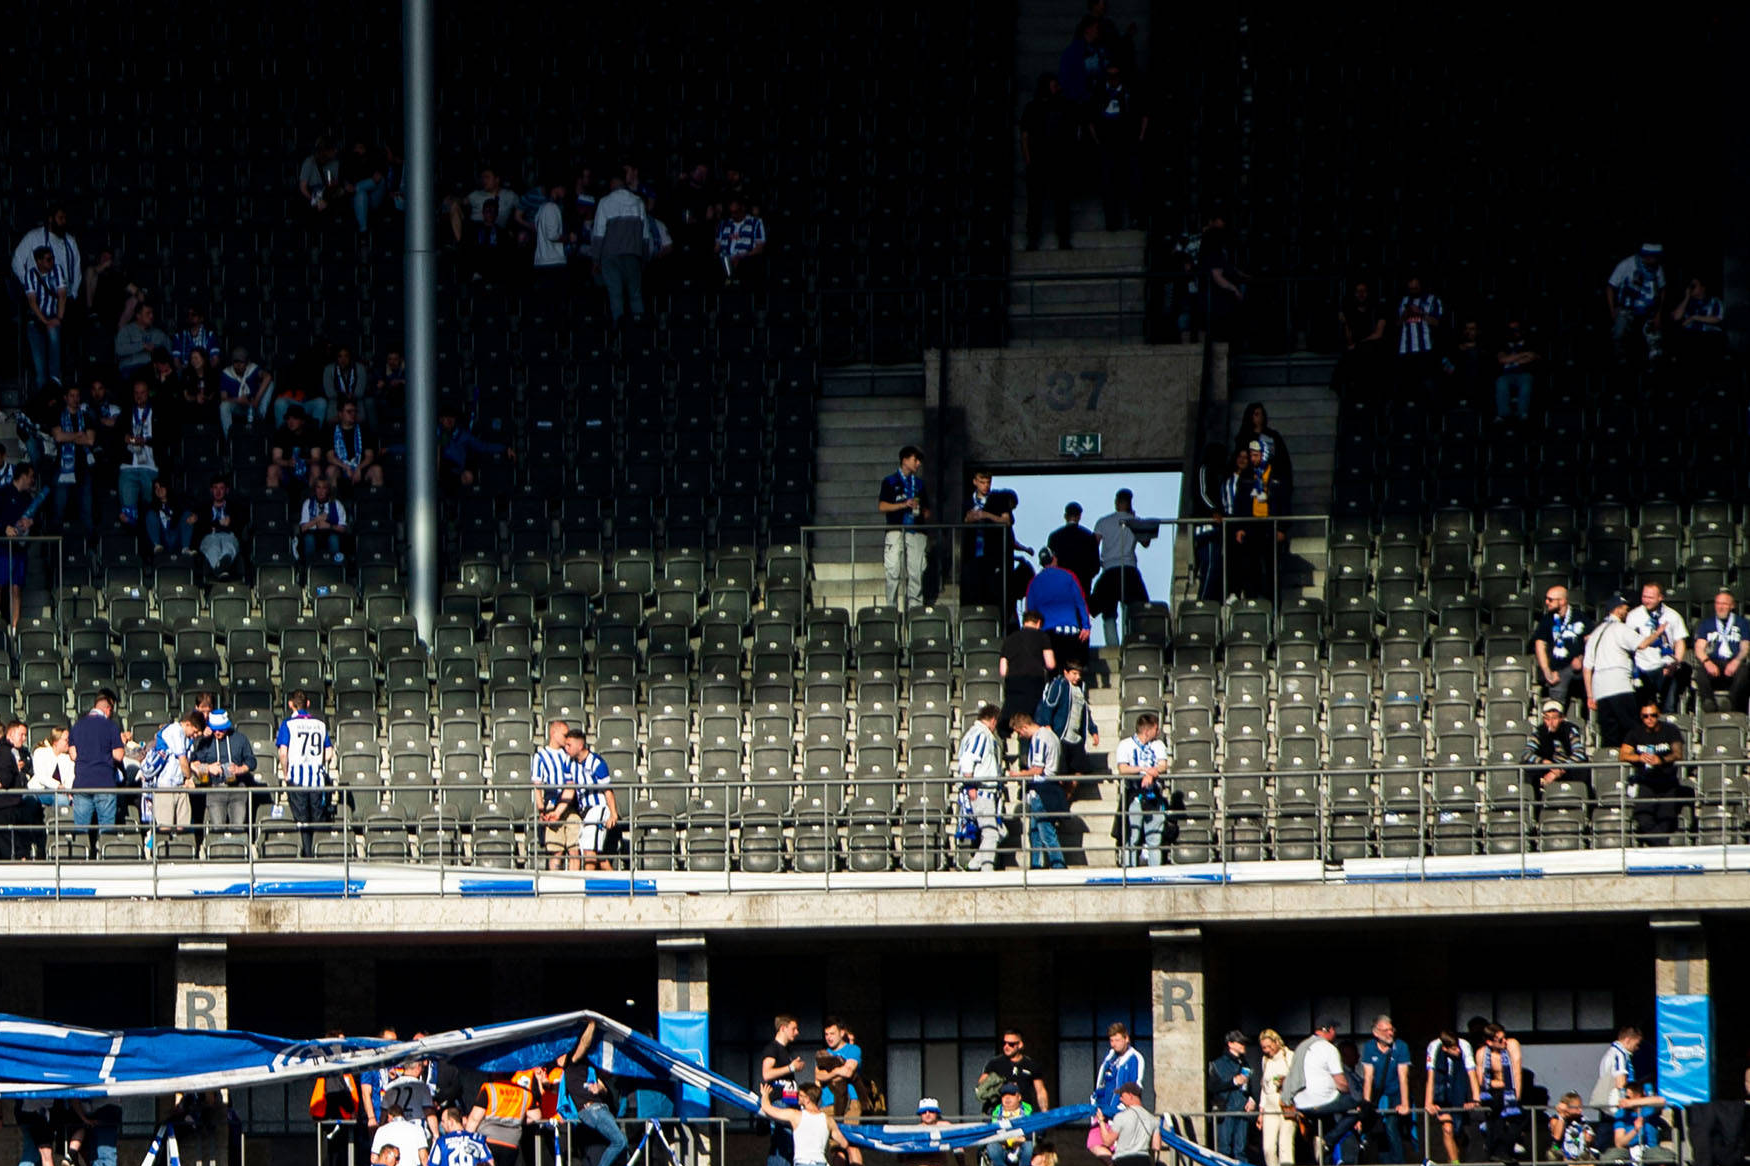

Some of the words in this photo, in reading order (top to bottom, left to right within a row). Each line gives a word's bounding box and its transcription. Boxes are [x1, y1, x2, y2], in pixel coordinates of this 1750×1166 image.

[1046, 370, 1109, 412] 37
[297, 731, 323, 757] 79
[185, 990, 217, 1031] R
[1162, 978, 1196, 1022] R
